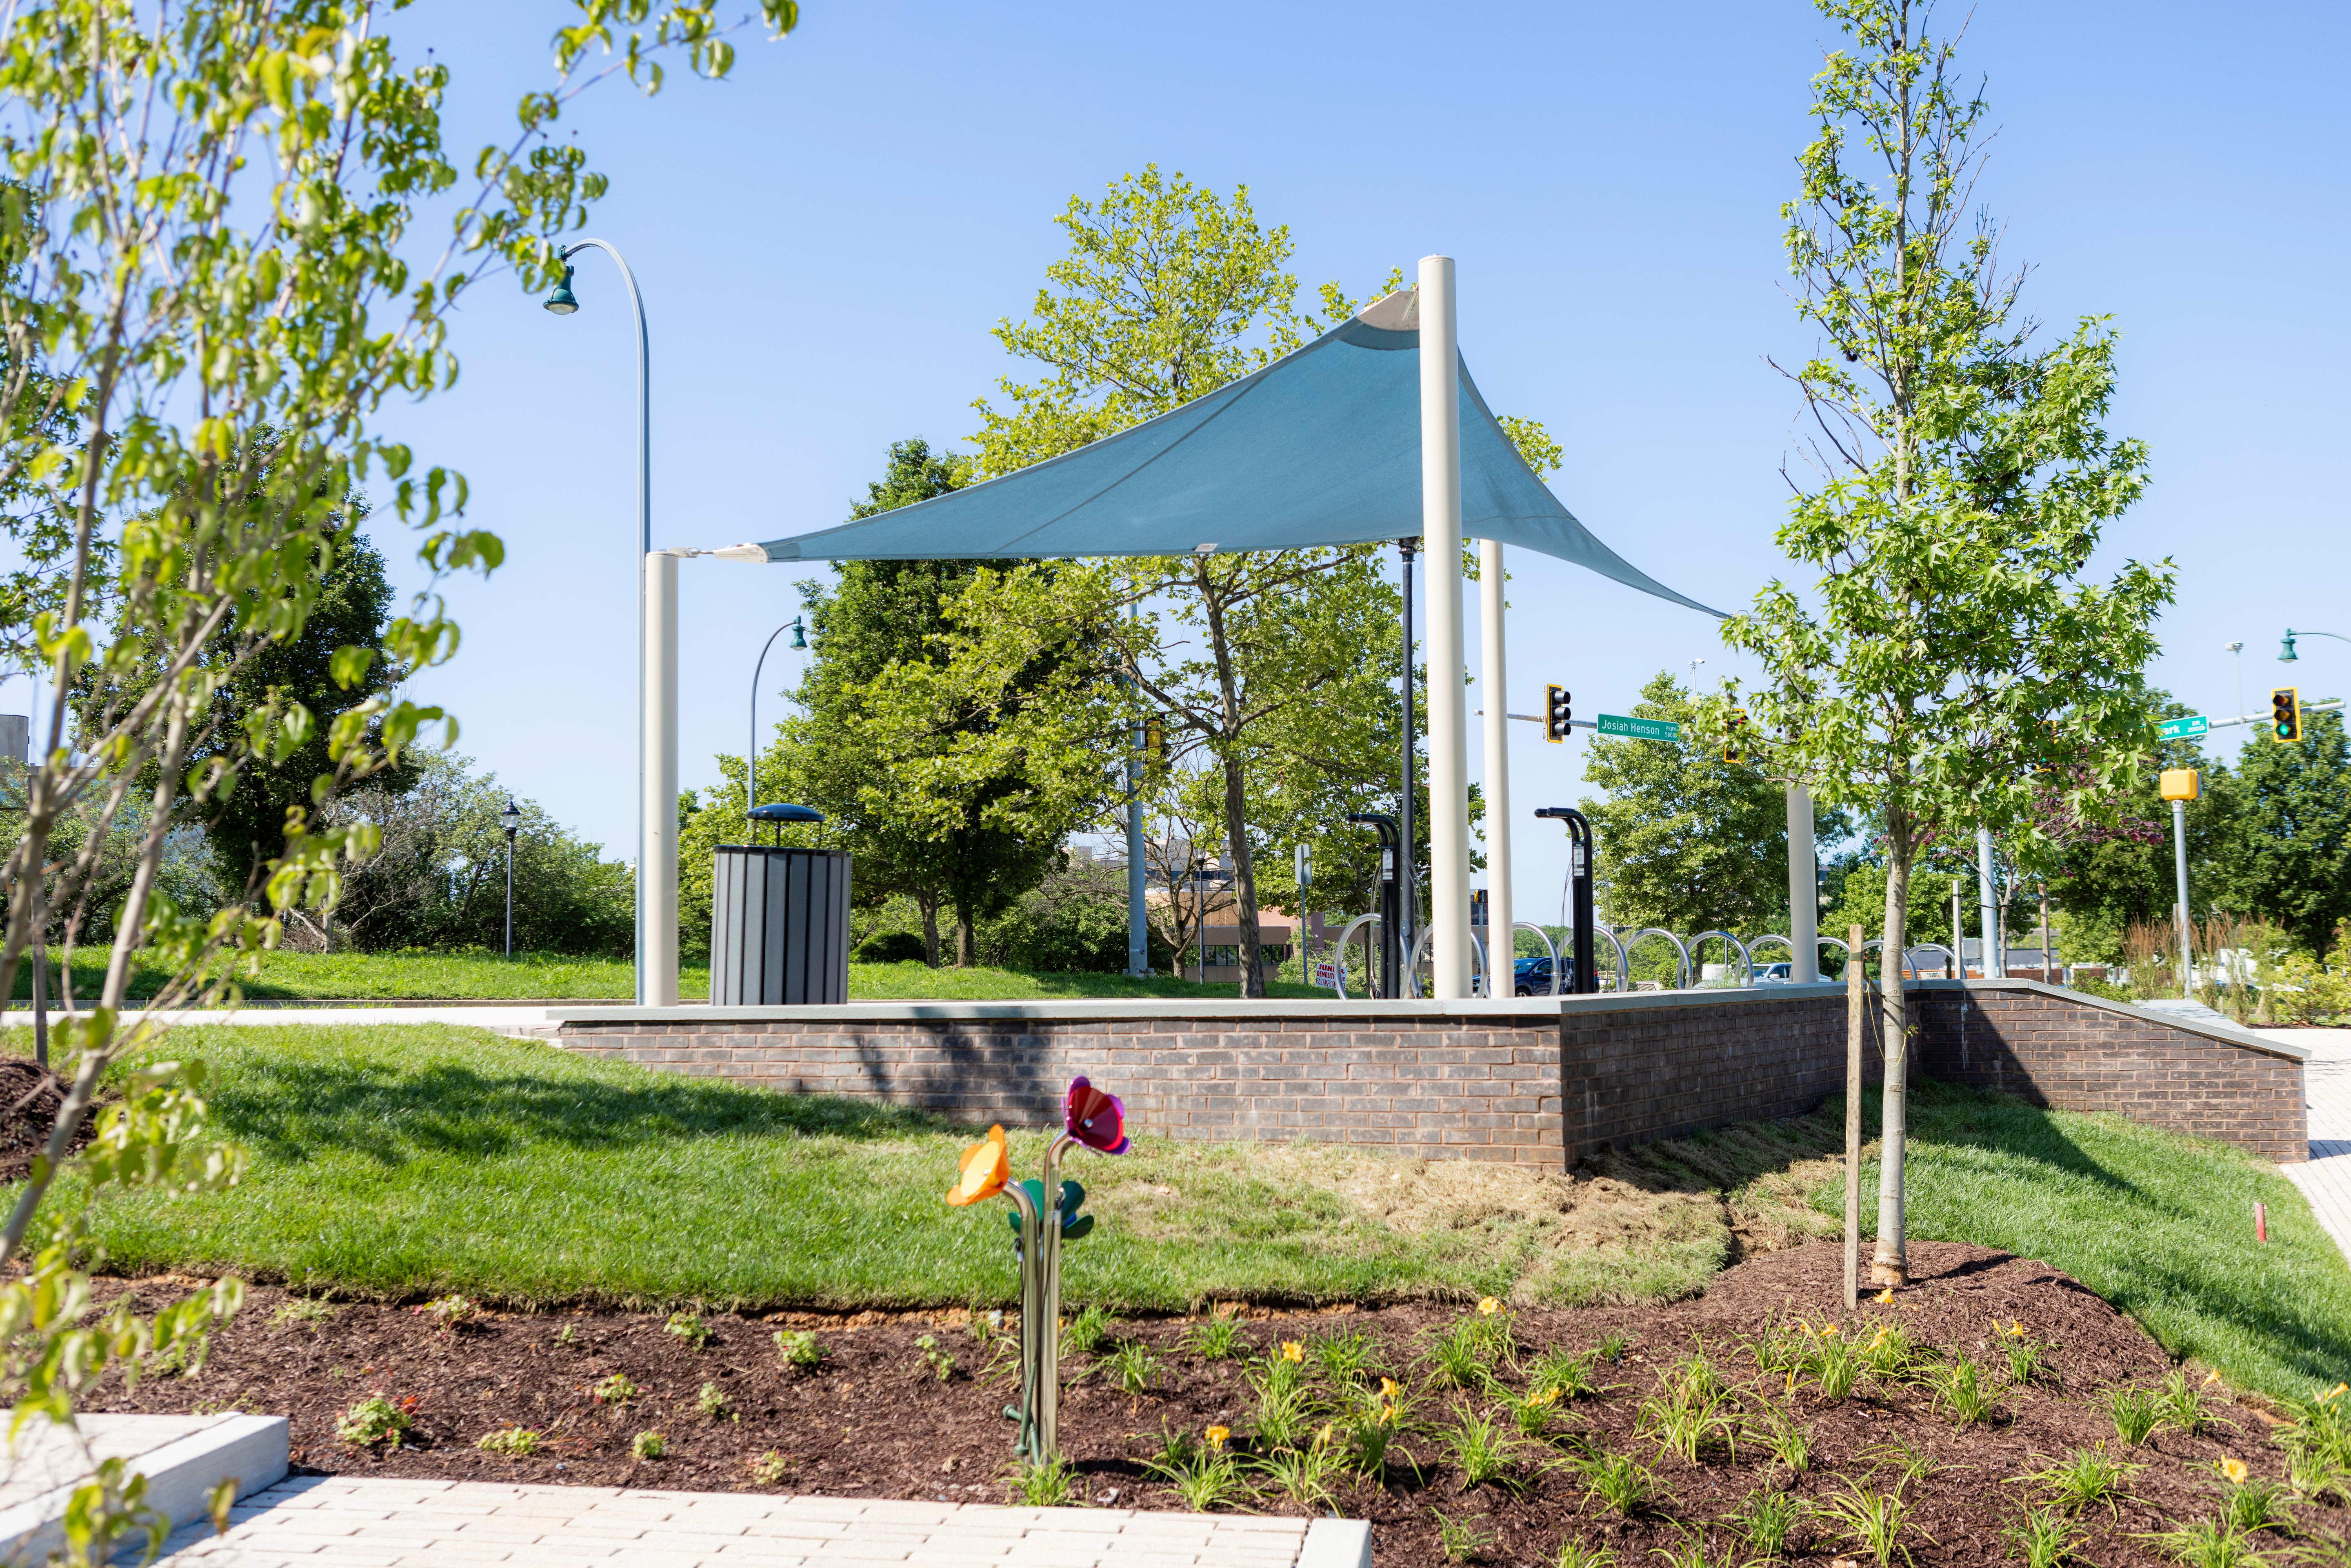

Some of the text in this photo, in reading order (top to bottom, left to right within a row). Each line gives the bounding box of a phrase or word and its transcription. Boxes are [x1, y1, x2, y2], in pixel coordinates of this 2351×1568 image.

[1602, 720, 1659, 735] Josiah Henson
[2163, 725, 2180, 735] ark
[1319, 964, 1334, 972] JUN
[1317, 971, 1335, 979] DEMOLITI
